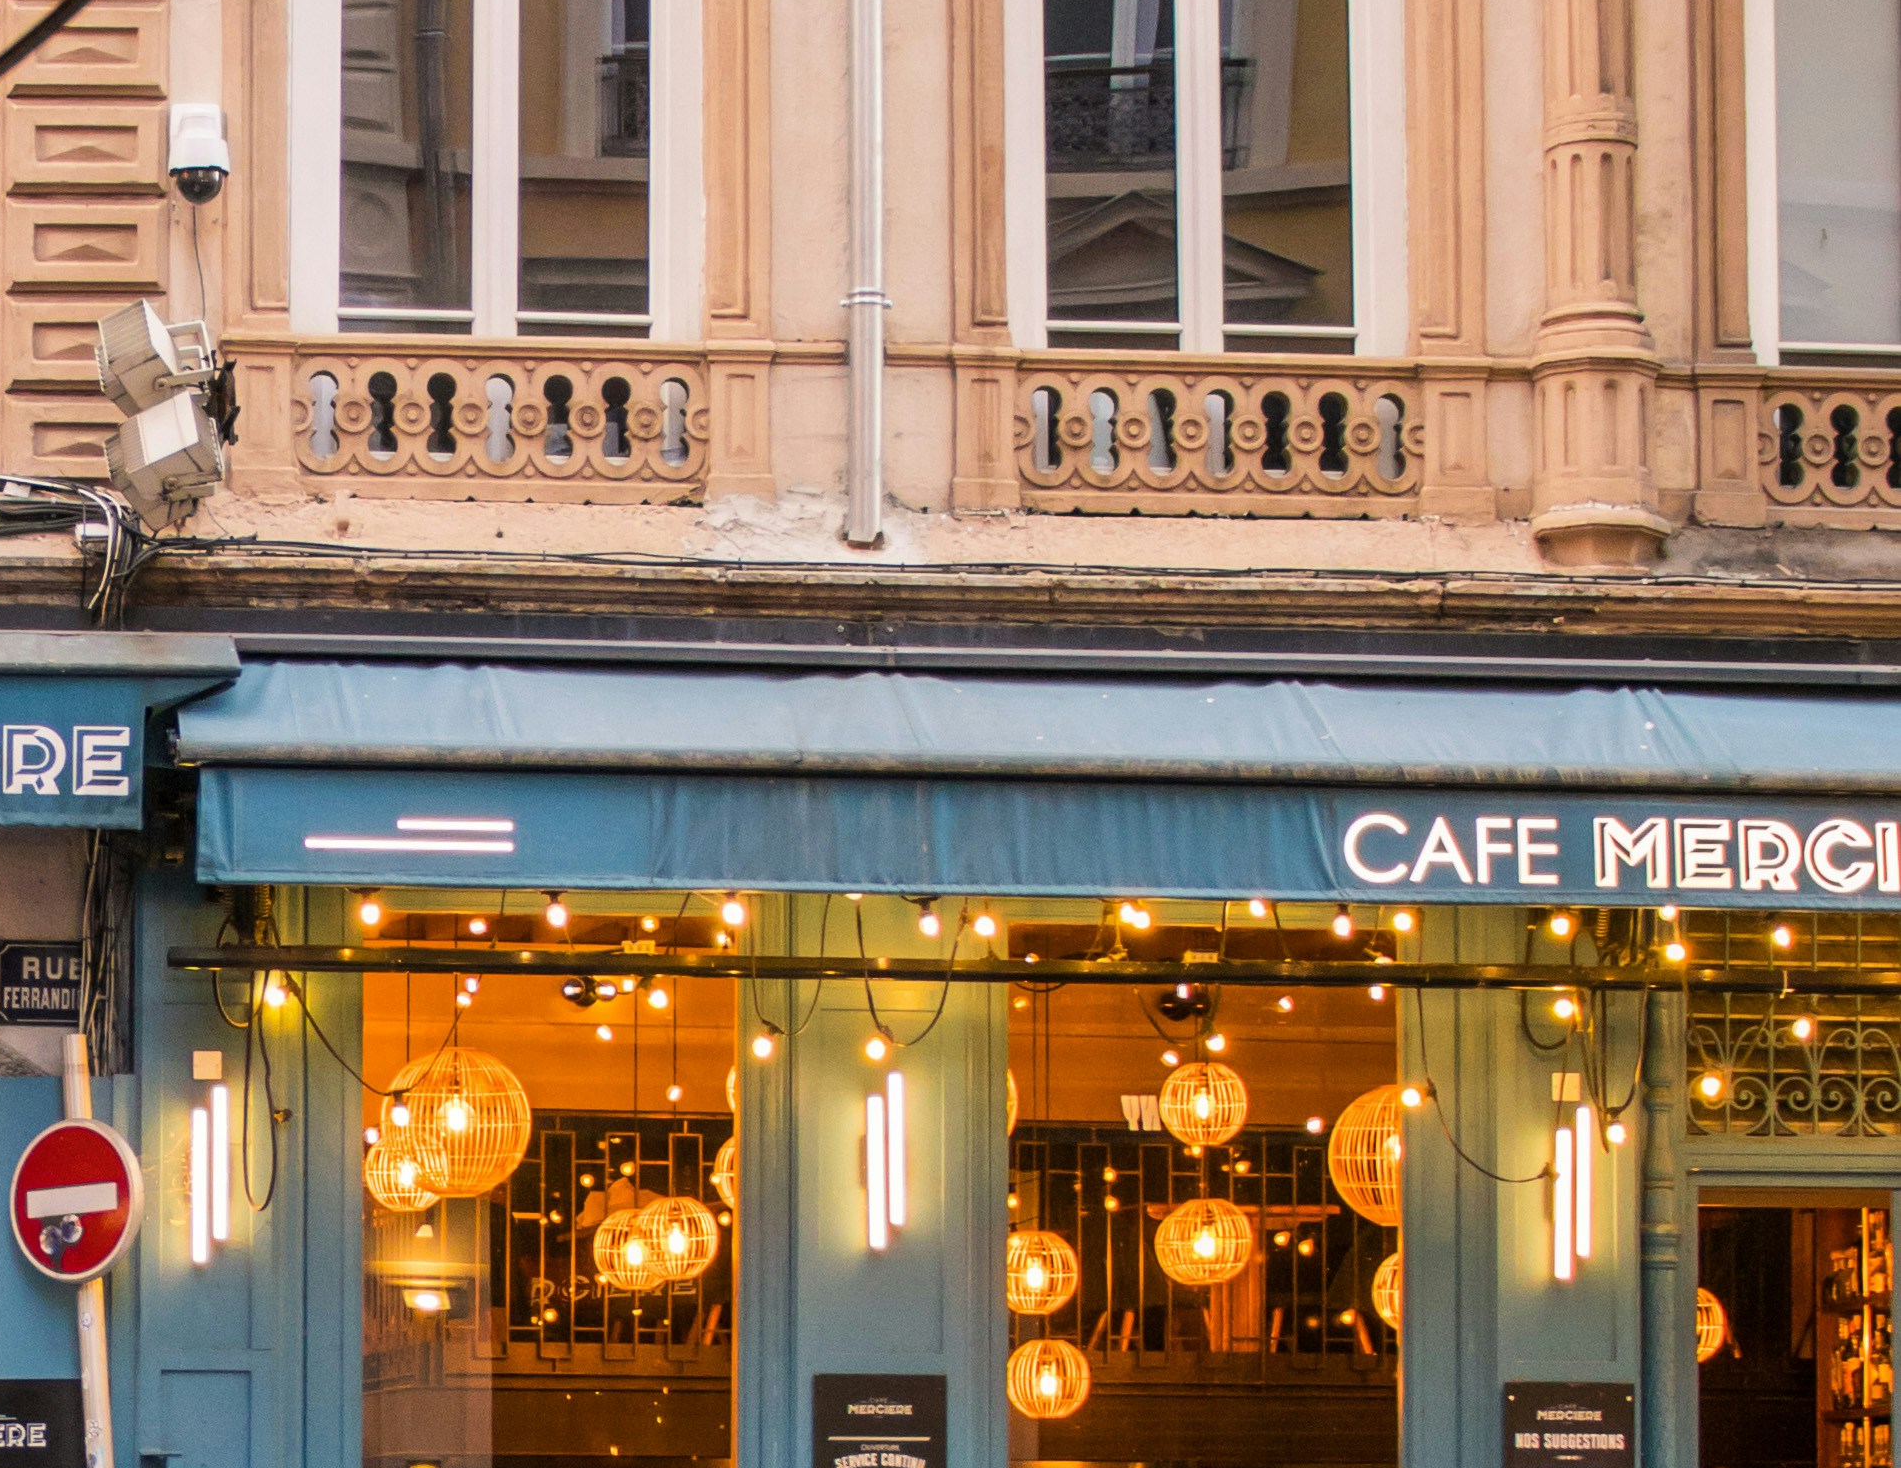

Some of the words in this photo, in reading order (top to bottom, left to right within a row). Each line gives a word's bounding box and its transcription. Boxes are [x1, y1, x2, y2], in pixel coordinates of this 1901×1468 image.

[1343, 813, 1559, 884] CAFE
[23, 956, 81, 980] RUE
[1515, 1433, 1540, 1449] NOS
[1543, 1433, 1625, 1450] SUGGESTIONS
